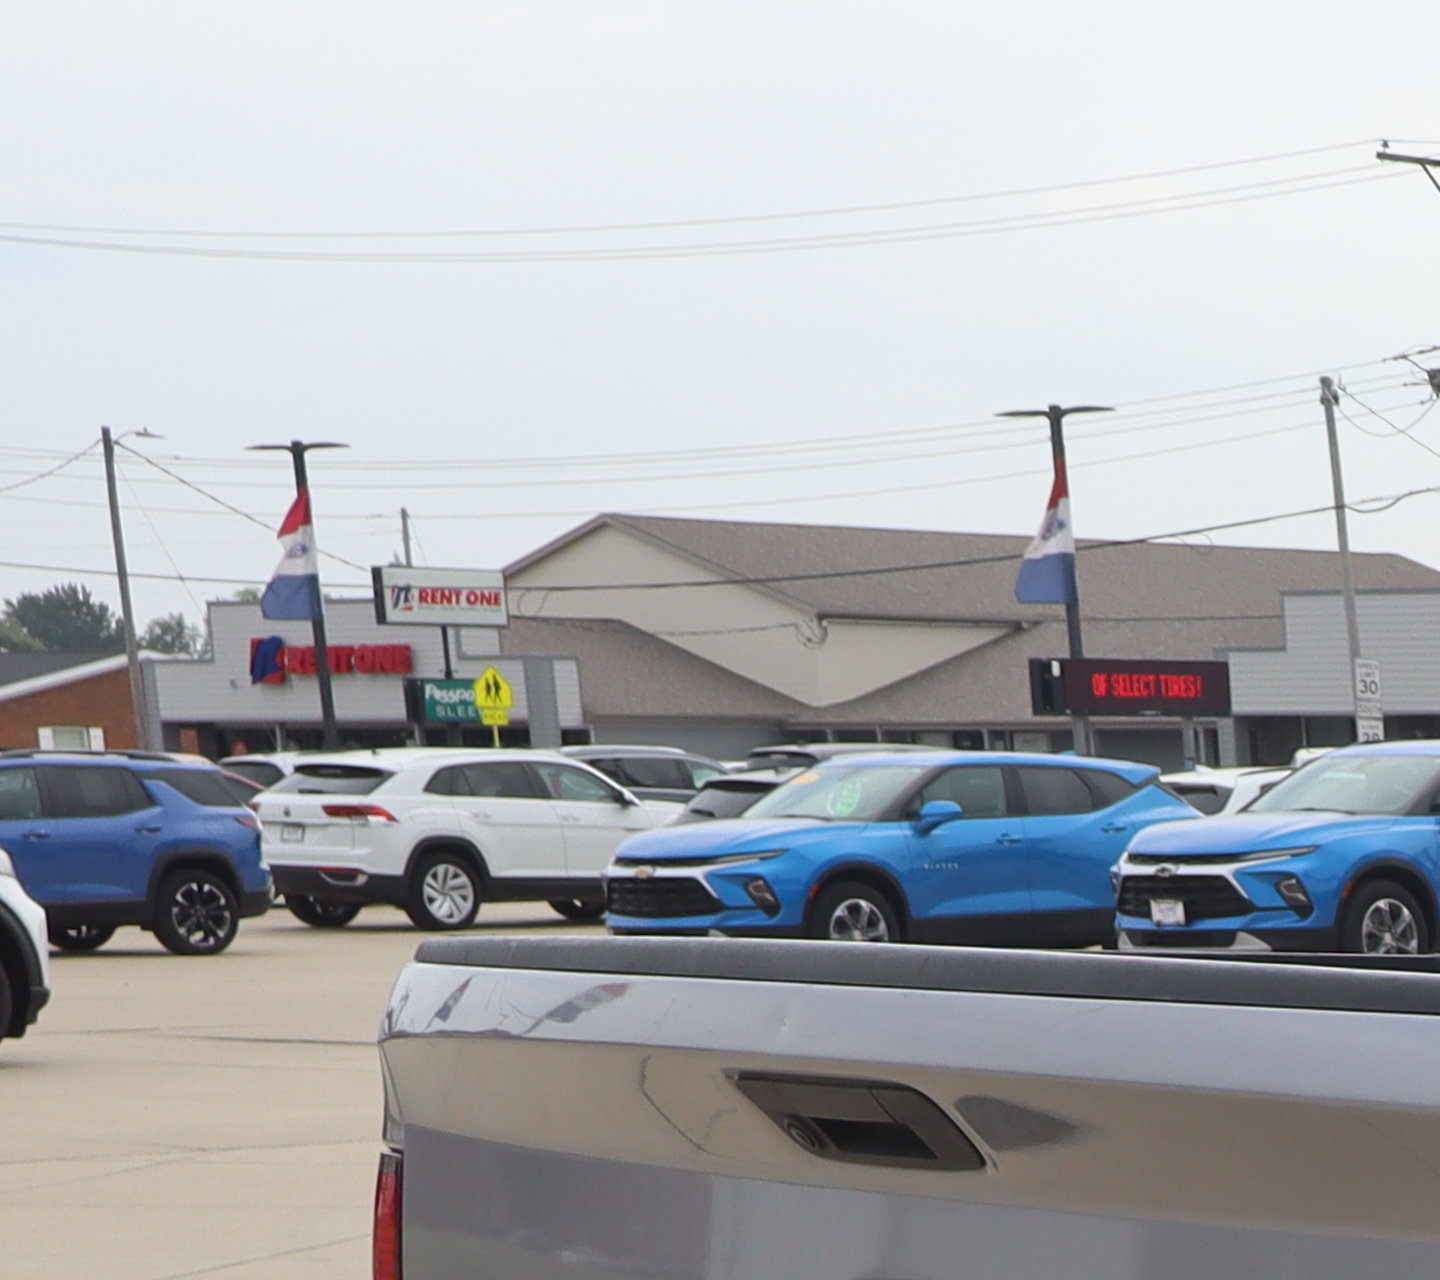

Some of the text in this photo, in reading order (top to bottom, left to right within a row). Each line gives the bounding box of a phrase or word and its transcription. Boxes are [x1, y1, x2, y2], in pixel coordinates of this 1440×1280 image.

[418, 588, 501, 607] RENT ONE
[356, 644, 412, 674] ONE
[1111, 673, 1156, 698] SELECT
[1360, 679, 1379, 695] 30
